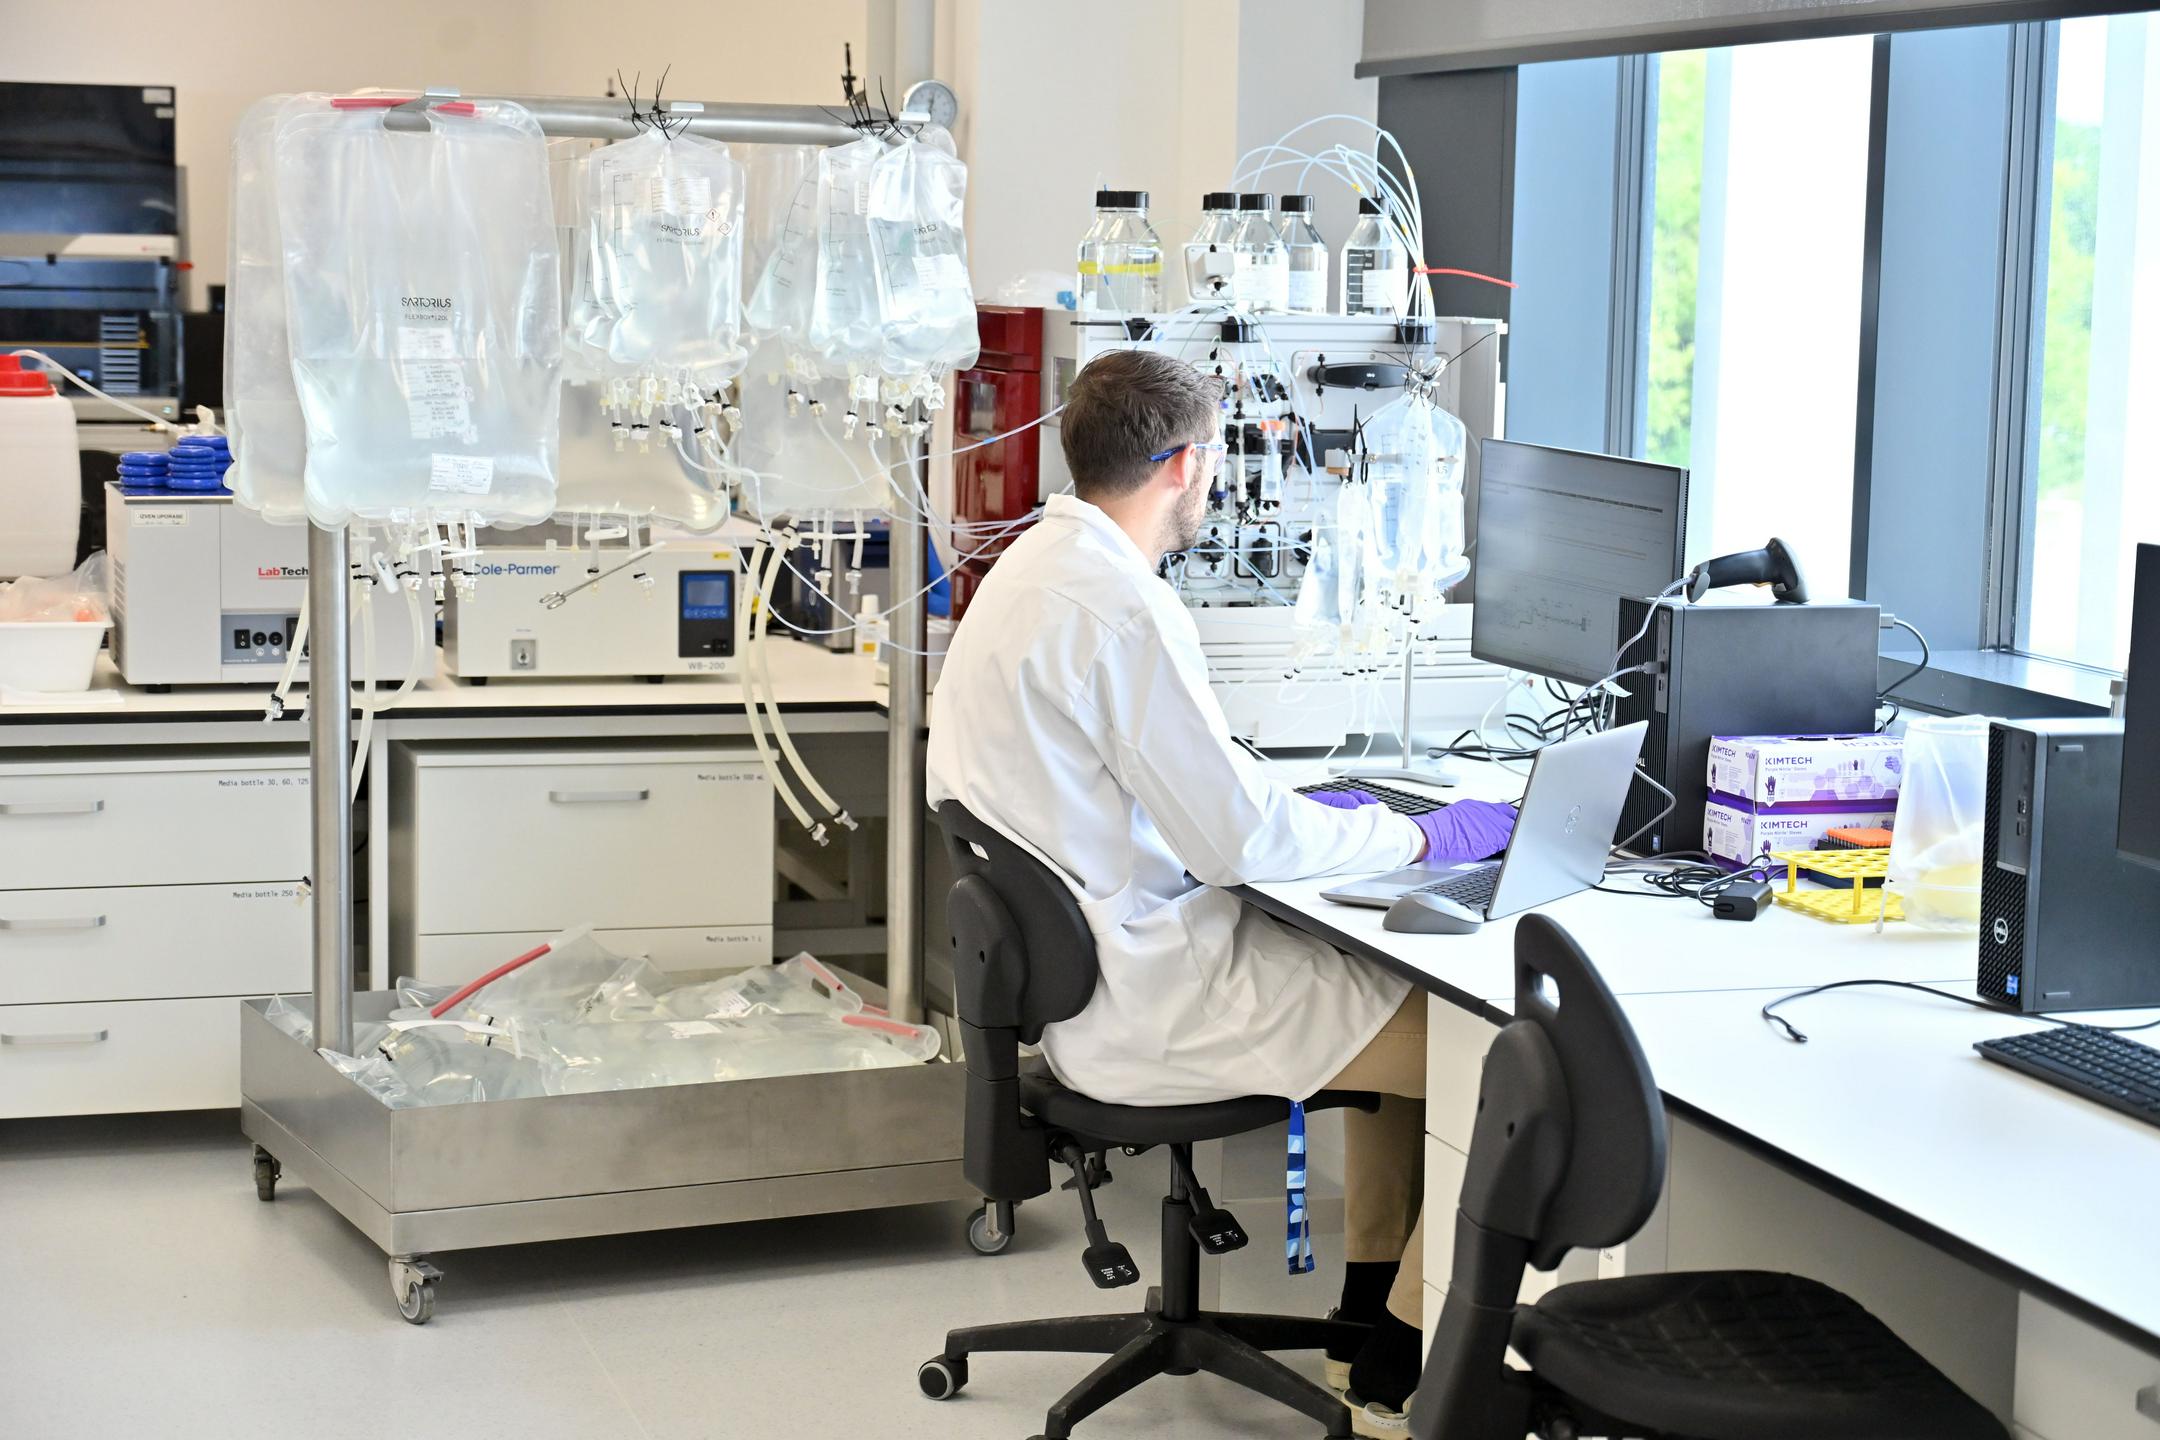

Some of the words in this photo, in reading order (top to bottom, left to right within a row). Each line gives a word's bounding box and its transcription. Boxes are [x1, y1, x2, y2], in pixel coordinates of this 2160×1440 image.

[401, 297, 452, 309] SARTORIUS
[258, 567, 309, 576] LabTech
[1712, 744, 1737, 758] KIMTECH
[1765, 756, 1813, 766] KIMTECH
[267, 778, 278, 787] 30,
[281, 778, 293, 786] 60,
[1760, 820, 1808, 829] KIMTECH
